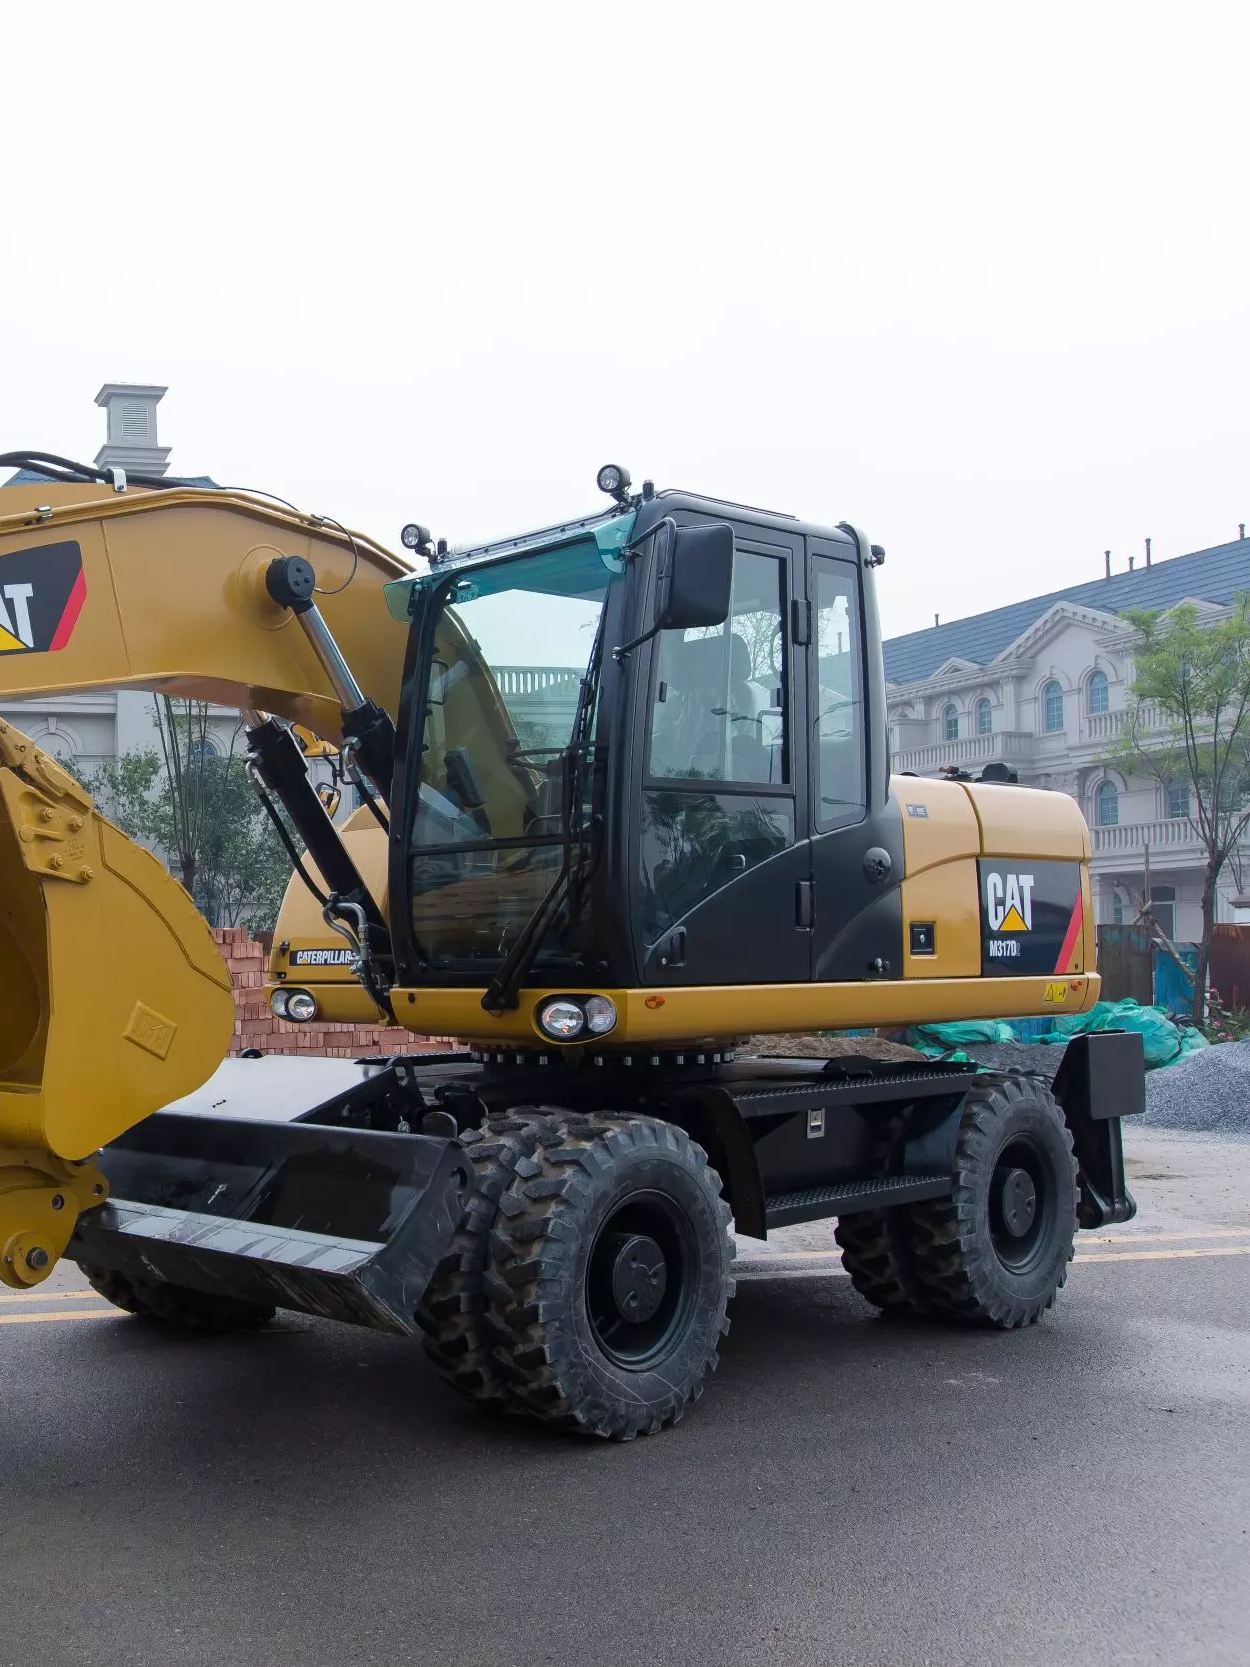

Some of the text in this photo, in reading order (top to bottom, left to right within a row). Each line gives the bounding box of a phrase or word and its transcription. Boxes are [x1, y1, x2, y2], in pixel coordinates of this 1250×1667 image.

[987, 873, 1034, 931] CAT
[990, 940, 1017, 956] M317D
[296, 950, 352, 964] CATERPILLAR
